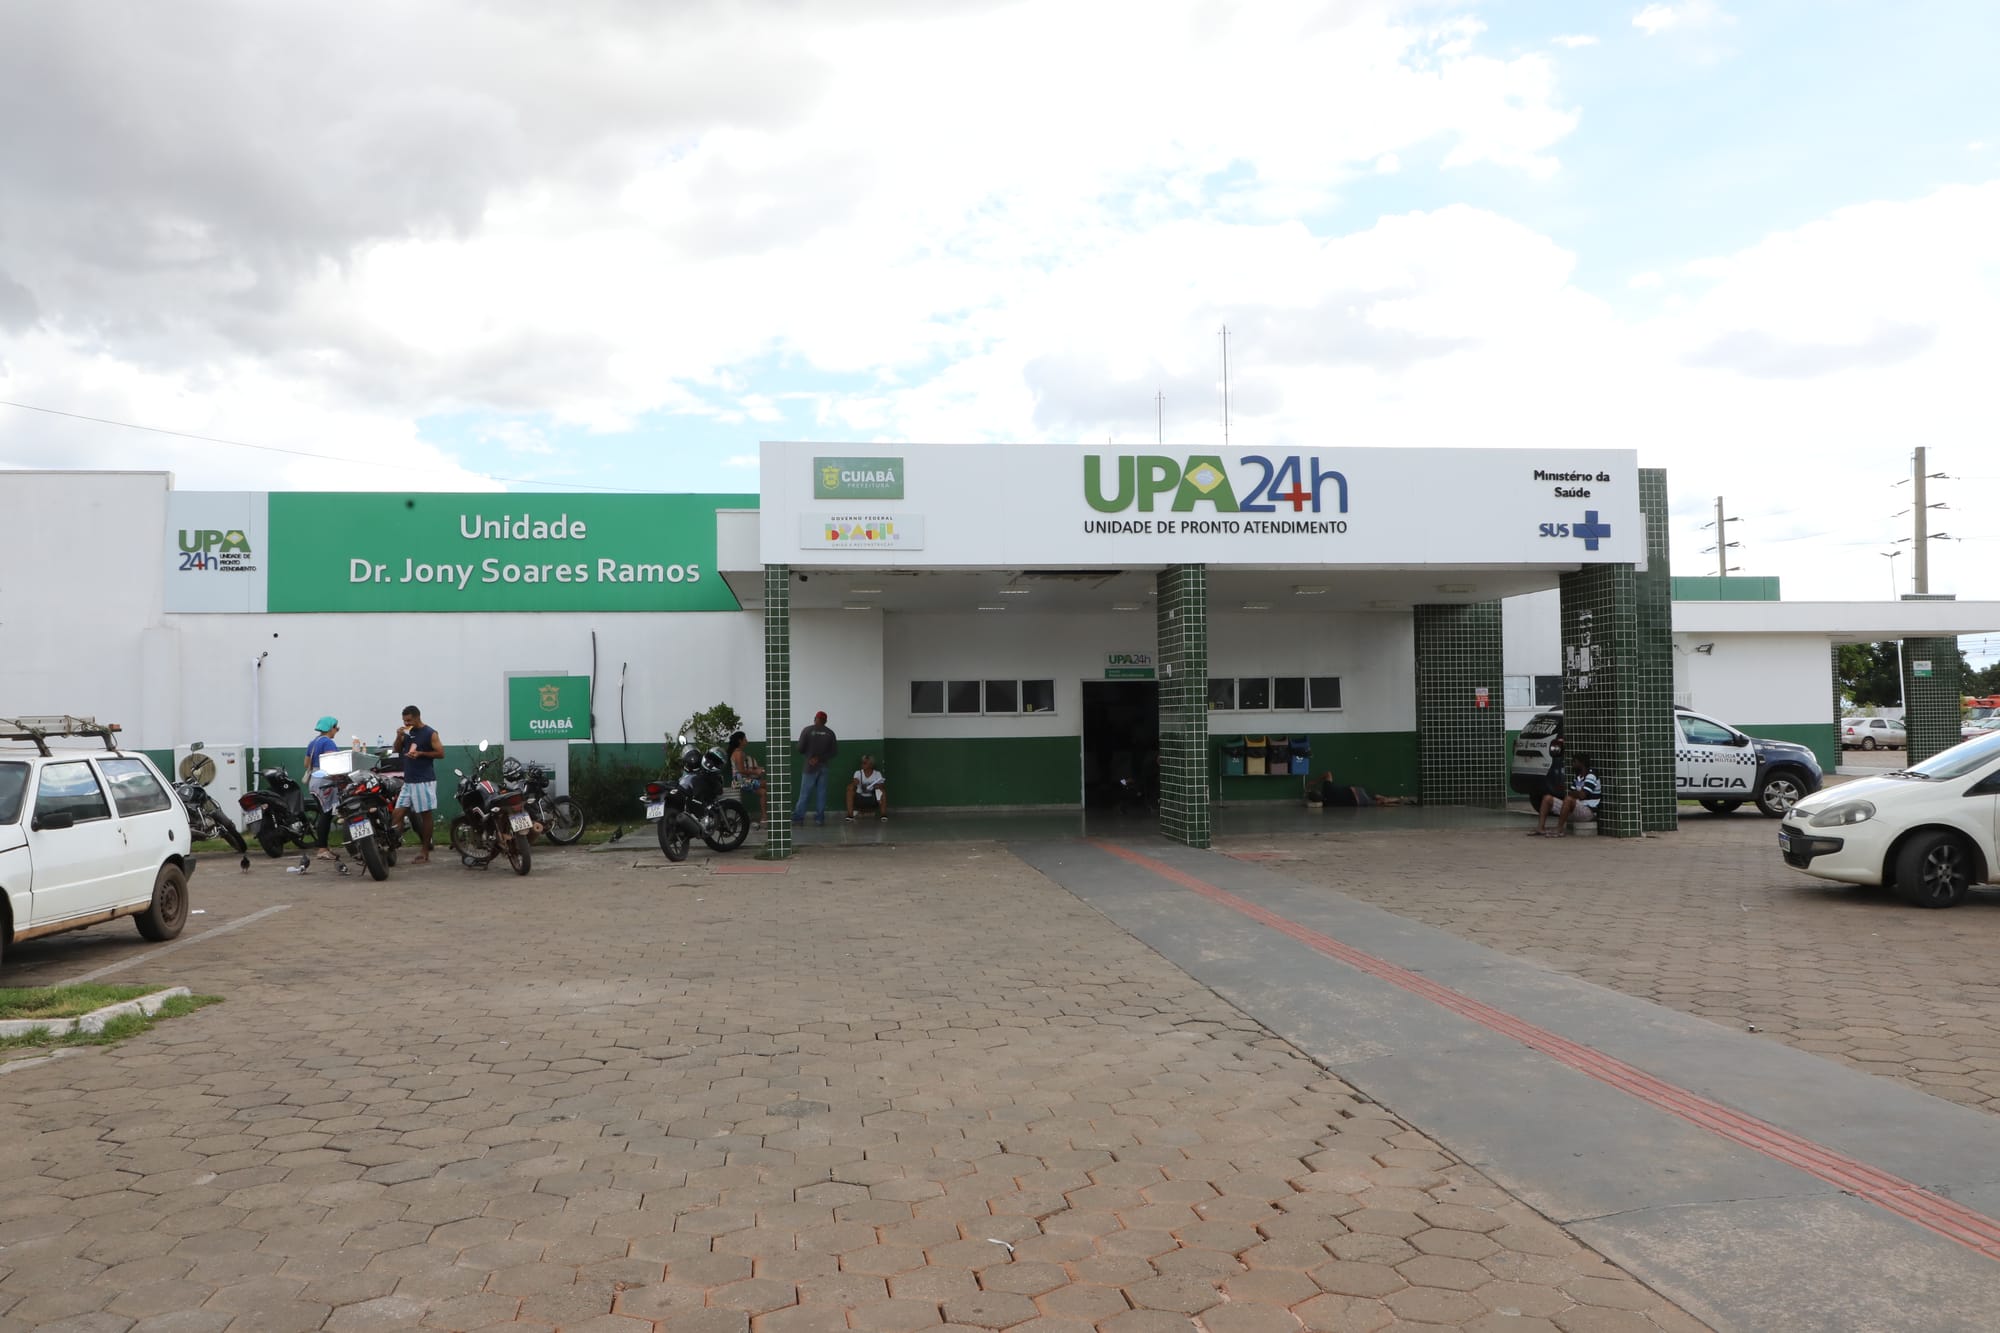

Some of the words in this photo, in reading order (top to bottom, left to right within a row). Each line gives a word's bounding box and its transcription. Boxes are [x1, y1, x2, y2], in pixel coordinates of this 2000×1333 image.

[841, 468, 895, 482] CUIABÁ
[1534, 470, 1592, 481] Ministério
[1596, 471, 1610, 481] da
[1554, 487, 1591, 498] Saúde
[460, 514, 586, 539] Unidade
[1084, 520, 1152, 534] UNIDADE
[1157, 520, 1176, 534] DE
[1181, 520, 1240, 534] PRONTO
[1244, 520, 1347, 534] ATENDIMENTO
[1539, 523, 1570, 537] SUS
[179, 530, 251, 553] UPA
[179, 552, 218, 570] 24h
[350, 558, 391, 583] Dr.
[400, 558, 473, 590] Jony
[481, 558, 589, 583] Soares
[597, 558, 700, 583] Ramos
[529, 717, 573, 729] CUIABÁ
[1676, 773, 1747, 788] OLÍCIA
